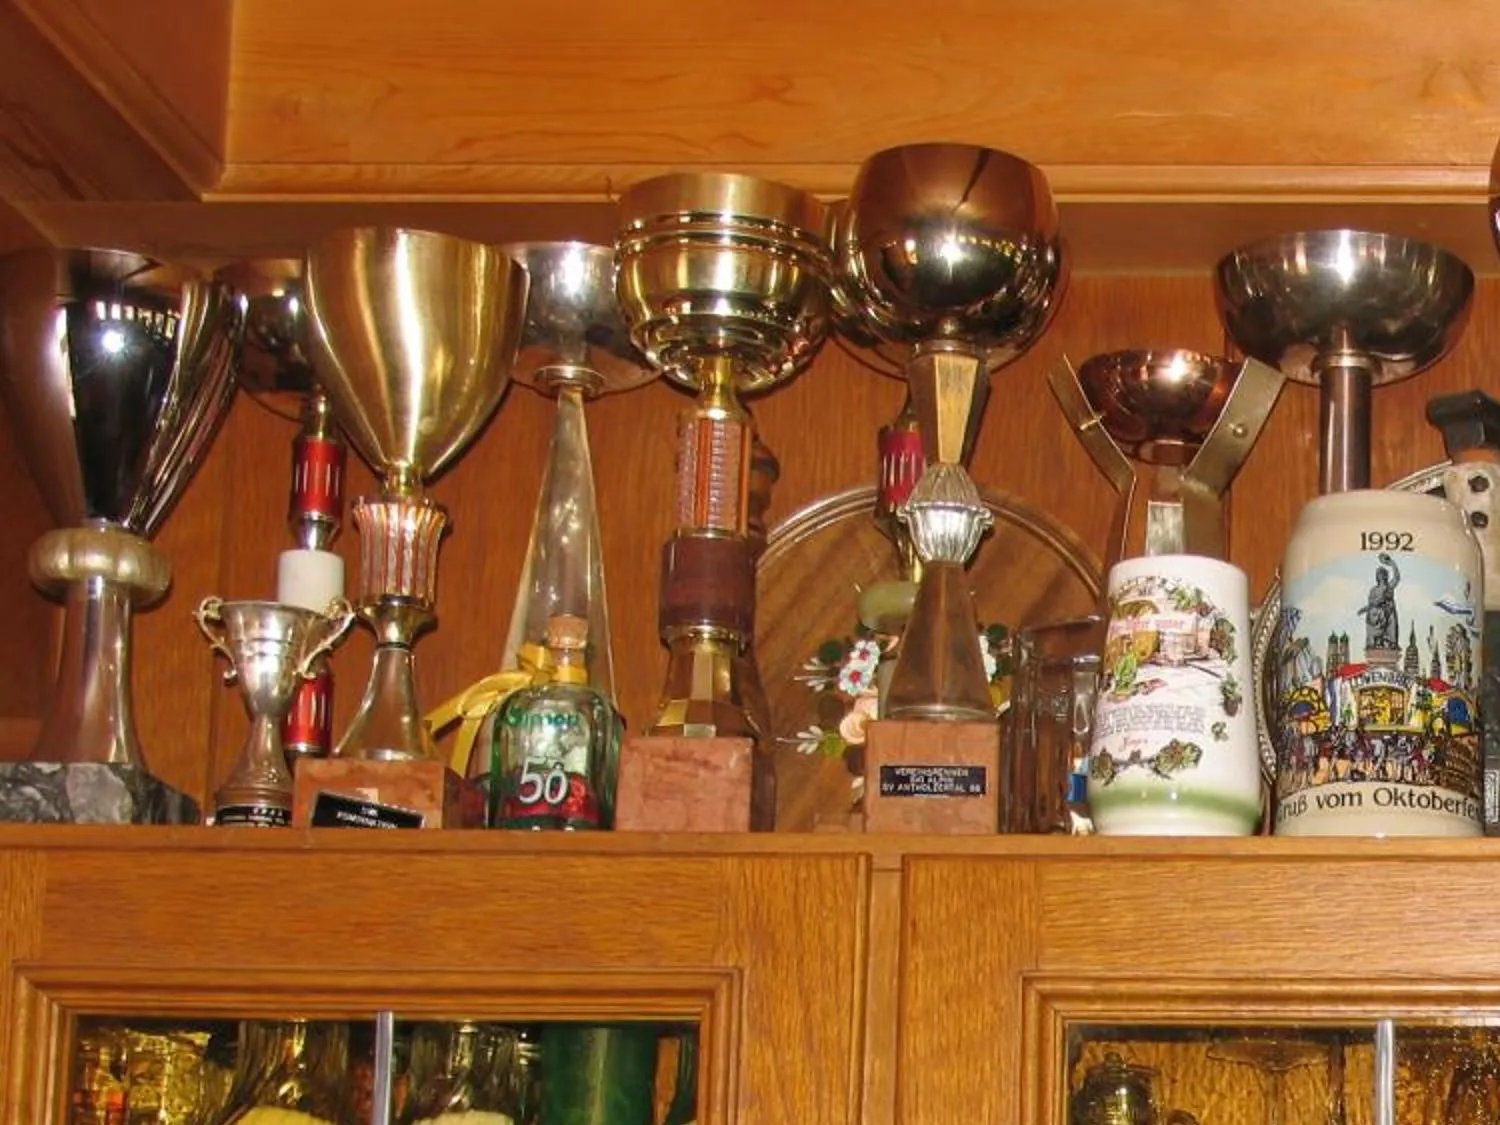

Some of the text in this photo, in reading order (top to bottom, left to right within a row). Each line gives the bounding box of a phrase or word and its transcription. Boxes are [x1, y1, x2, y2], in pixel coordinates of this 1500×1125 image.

[1360, 531, 1415, 551] 1992
[518, 755, 569, 805] 50
[1315, 789, 1363, 810] vom
